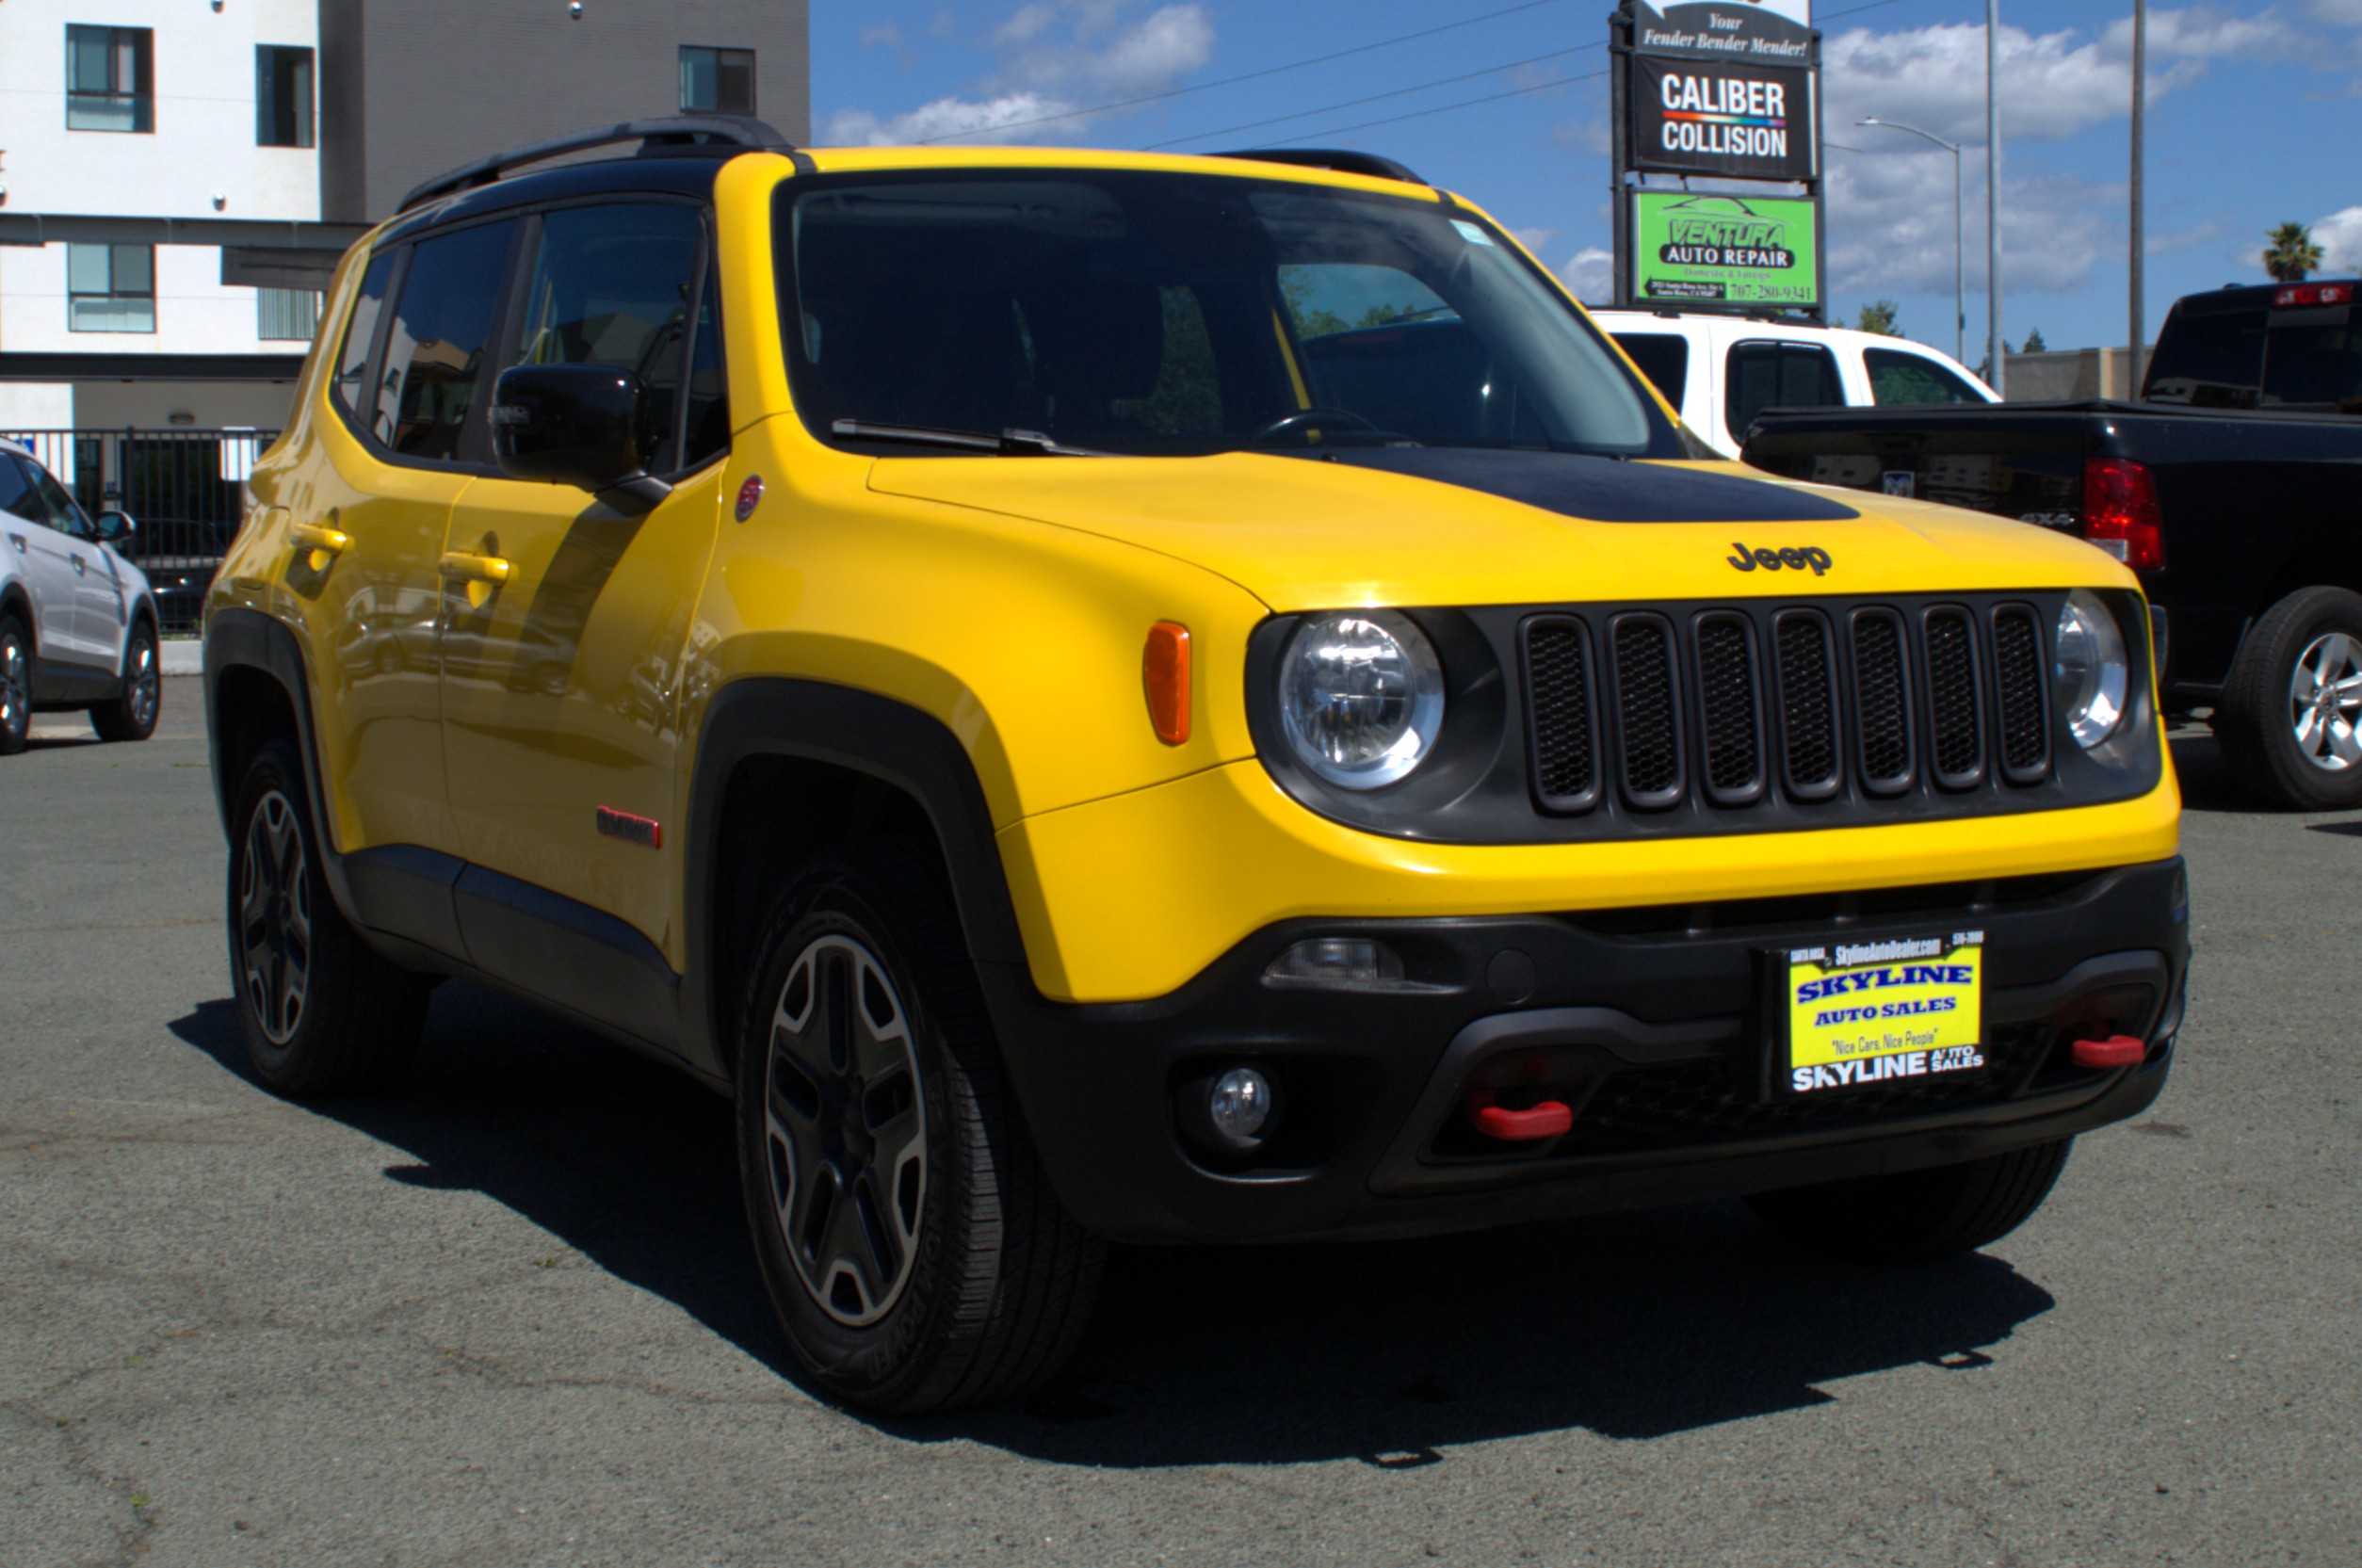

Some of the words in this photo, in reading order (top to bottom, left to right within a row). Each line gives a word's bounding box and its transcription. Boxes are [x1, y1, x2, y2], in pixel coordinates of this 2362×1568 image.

[1708, 13, 1742, 30] Your
[1643, 29, 1695, 46] Fender
[1696, 33, 1748, 50] Bender
[1751, 39, 1807, 57] Mender!
[1661, 73, 1785, 117] CALIBER
[1662, 121, 1787, 157] COLLISION
[1670, 218, 1785, 247] VENTURA
[1667, 247, 1719, 263] AUTO
[1724, 250, 1788, 267] REPAIR
[1726, 542, 1833, 576] Jeep
[1797, 965, 1973, 1004] SKYLINE
[1815, 1006, 1877, 1026] AUTO
[1882, 997, 1956, 1018] SALES
[1884, 1032, 1902, 1050] Nice
[1932, 1045, 1975, 1061] AUTO
[1792, 1051, 1927, 1091] SKYLINE
[1932, 1055, 1983, 1073] SALES
